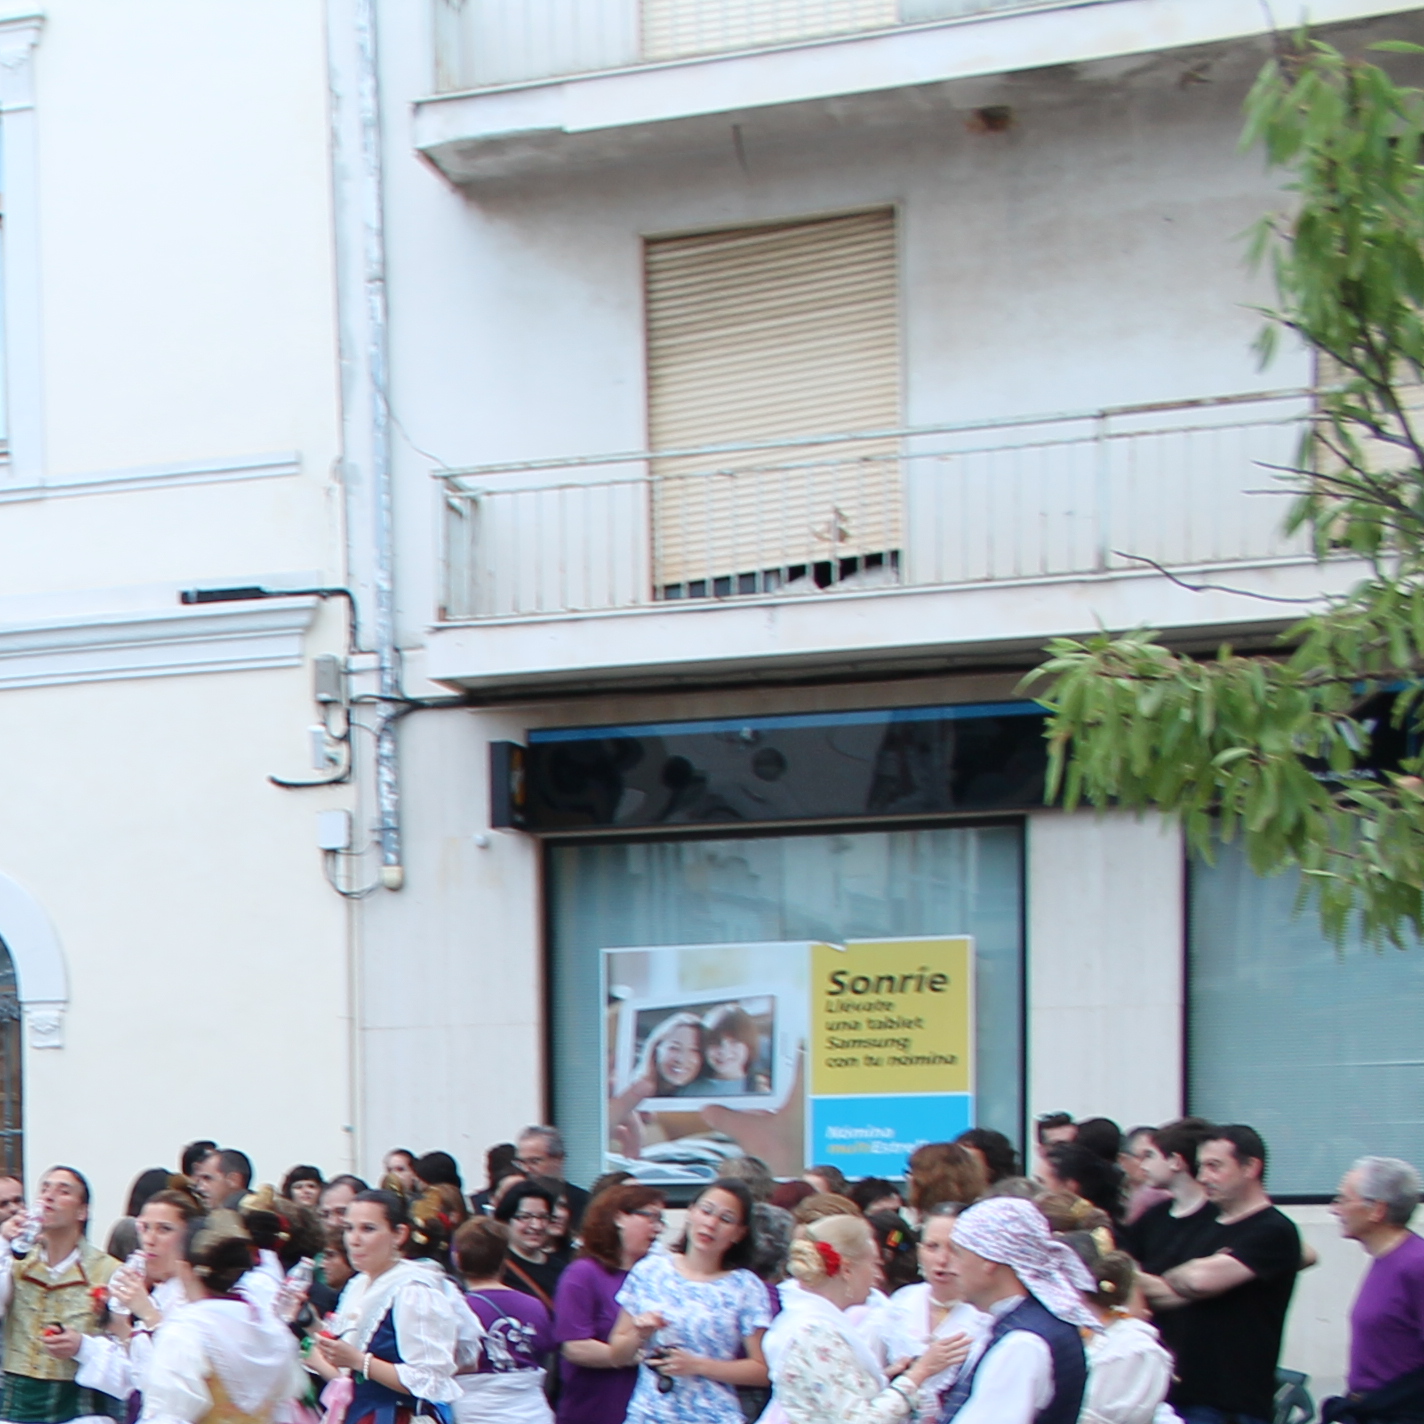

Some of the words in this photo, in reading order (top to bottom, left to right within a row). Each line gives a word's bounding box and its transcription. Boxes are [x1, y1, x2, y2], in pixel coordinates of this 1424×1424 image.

[825, 1020, 861, 1031] una
[866, 1015, 924, 1030] tablet
[824, 1036, 911, 1052] Samsung
[825, 1056, 859, 1068] con
